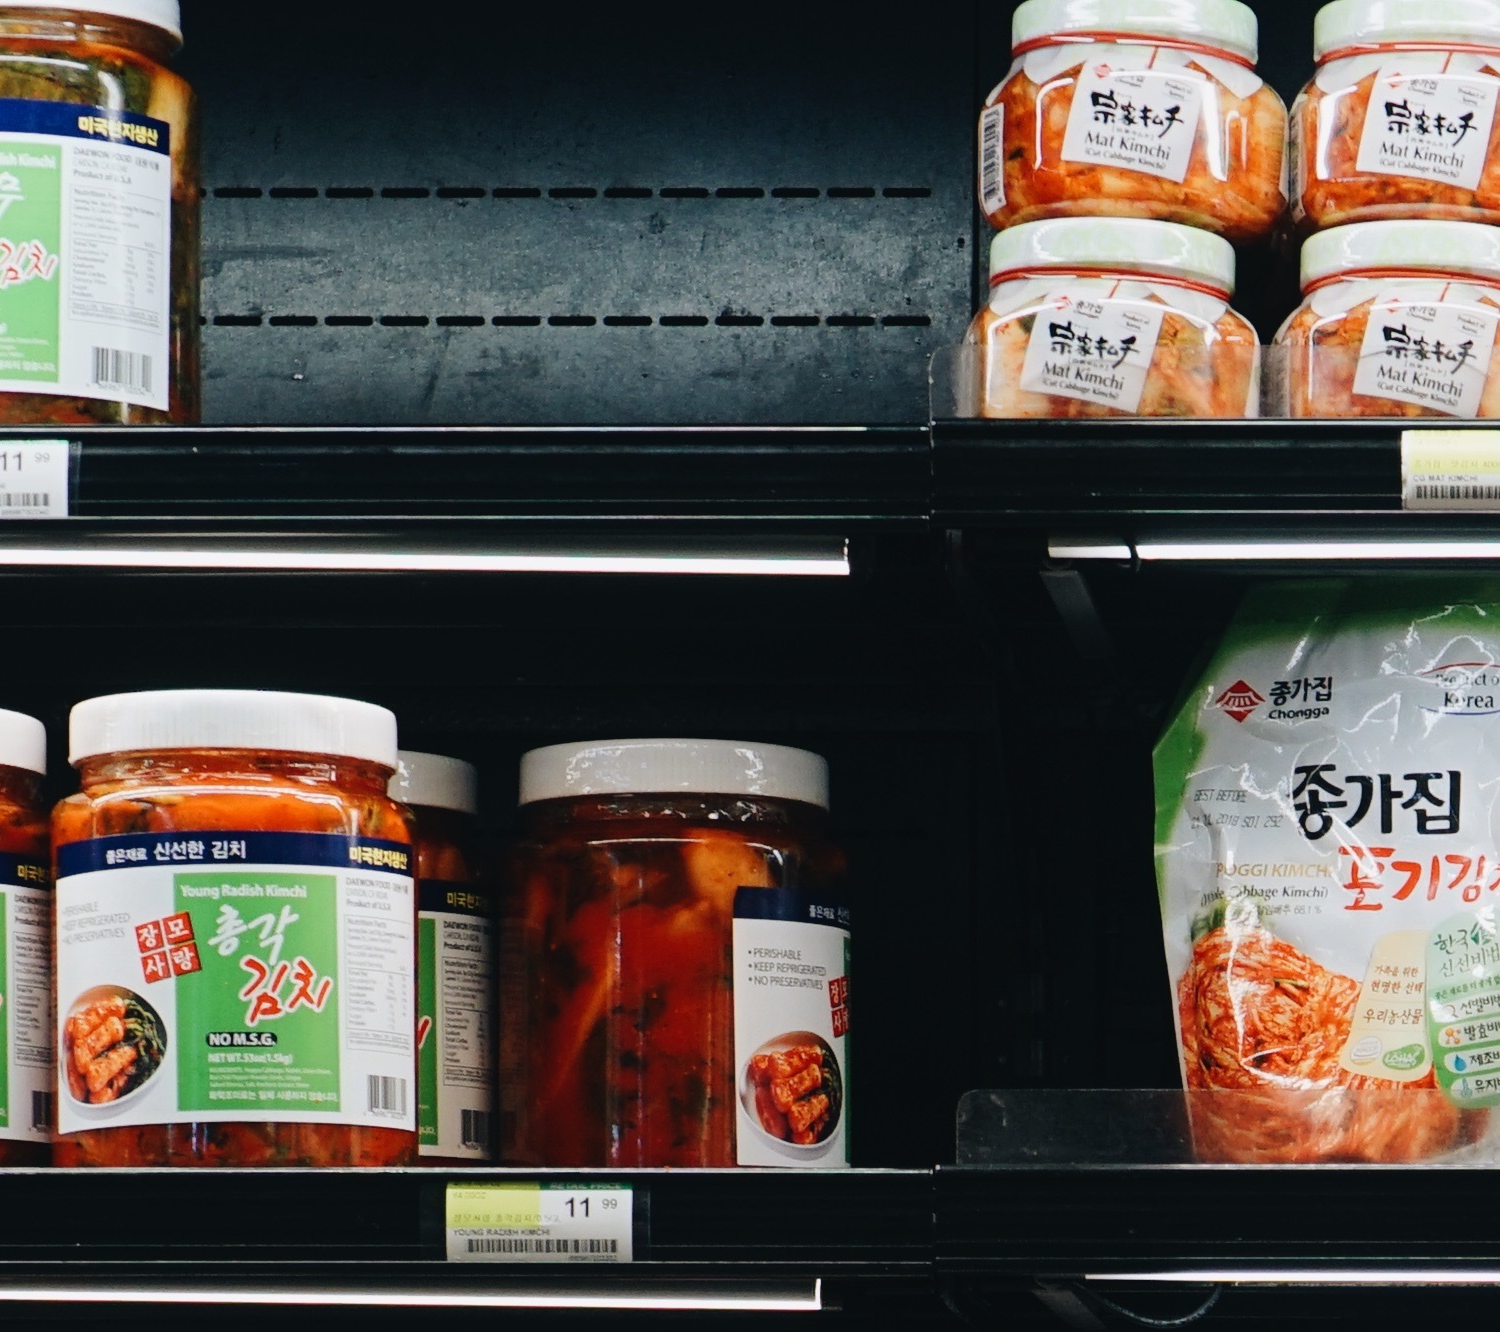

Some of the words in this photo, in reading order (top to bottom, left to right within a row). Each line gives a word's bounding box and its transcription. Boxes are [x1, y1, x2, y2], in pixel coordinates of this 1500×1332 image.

[1085, 130, 1117, 152] Mat
[1120, 137, 1173, 162] Kimchi
[1379, 139, 1411, 160] Mat
[1413, 145, 1465, 172] Kimchi
[33, 451, 51, 464] 99
[1268, 703, 1330, 720] Chongga
[1290, 763, 1462, 840] 종가집
[207, 905, 299, 965] 총각
[753, 946, 802, 963] PERISHABLE
[753, 961, 774, 973] KEEP
[238, 955, 335, 1026] 김치
[564, 1197, 591, 1219] 11
[601, 1198, 618, 1210] 99
